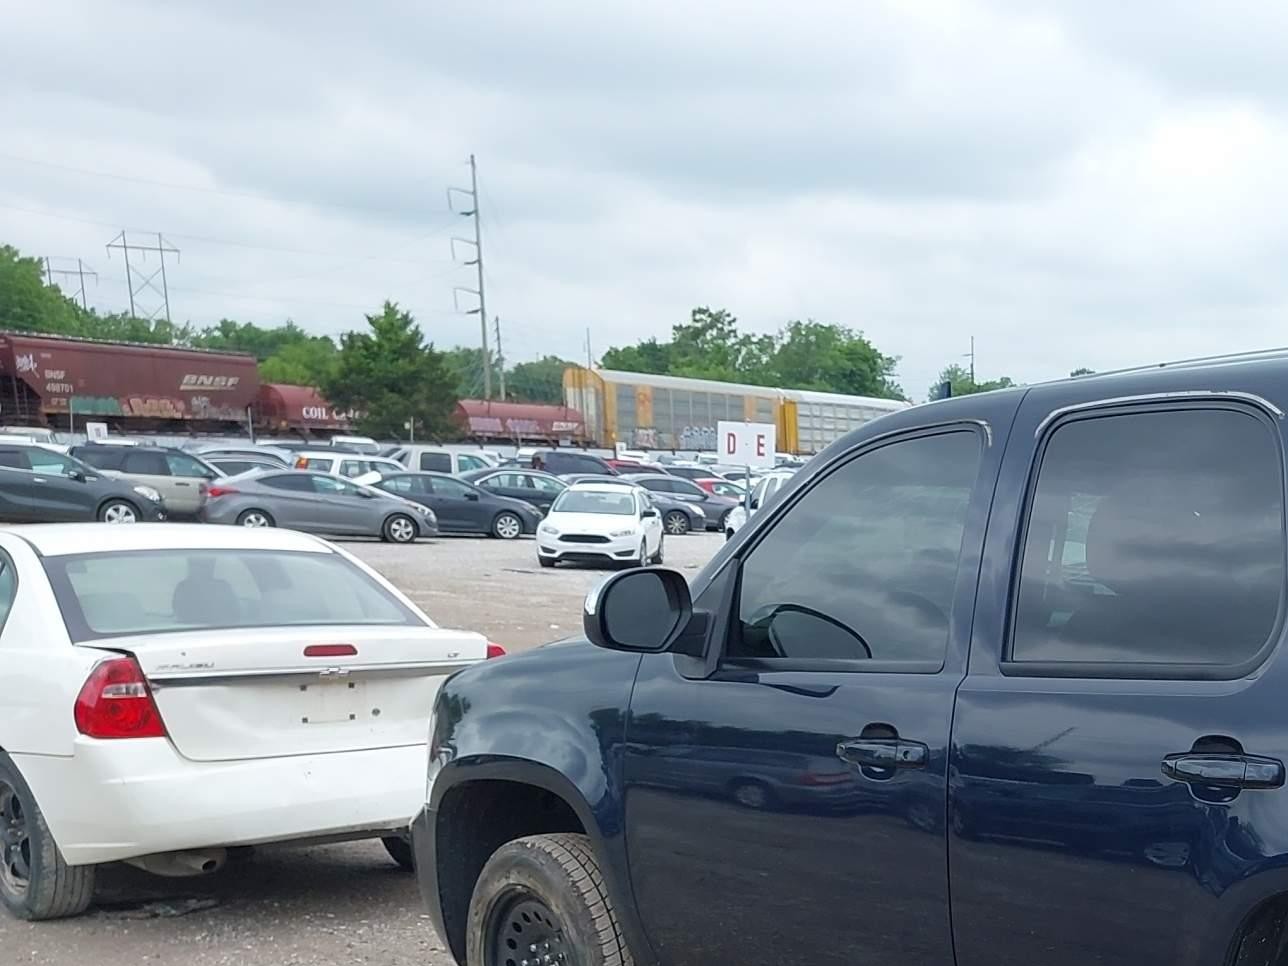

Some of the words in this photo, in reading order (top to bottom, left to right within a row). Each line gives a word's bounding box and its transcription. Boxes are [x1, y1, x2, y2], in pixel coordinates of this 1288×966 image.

[182, 374, 240, 387] BNSF
[302, 406, 329, 419] COIL
[727, 432, 737, 455] D
[757, 434, 766, 457] E
